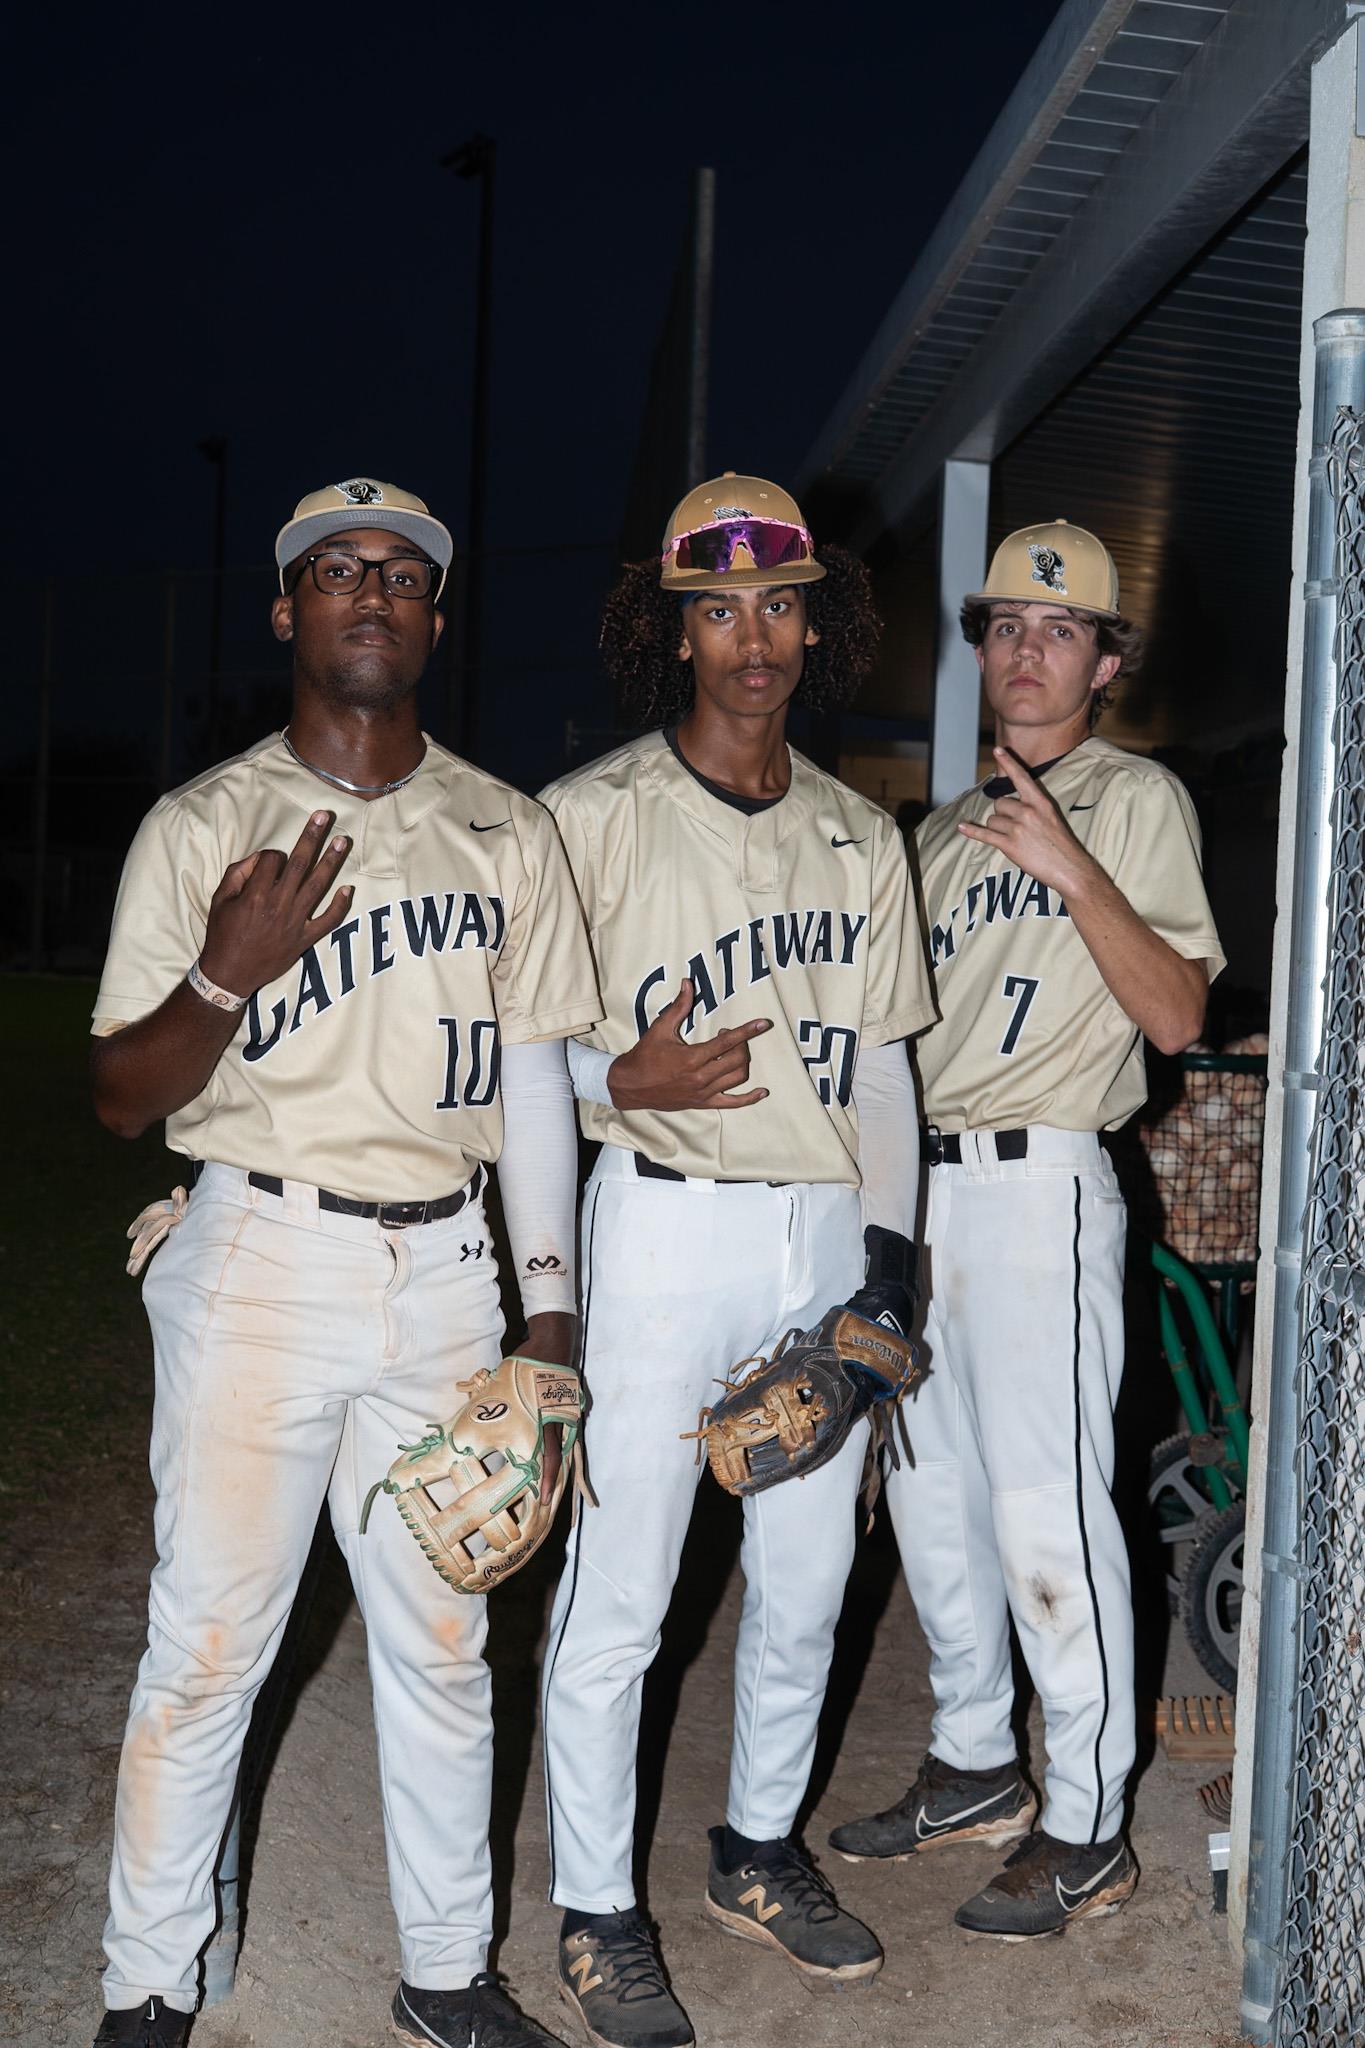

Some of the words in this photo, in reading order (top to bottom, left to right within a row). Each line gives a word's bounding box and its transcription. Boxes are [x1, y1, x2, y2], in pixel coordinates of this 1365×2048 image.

[998, 973, 1042, 1057] 7
[434, 1015, 501, 1112] 10
[799, 1017, 858, 1109] 20
[737, 1883, 783, 1923] N
[568, 1952, 603, 1998] N
